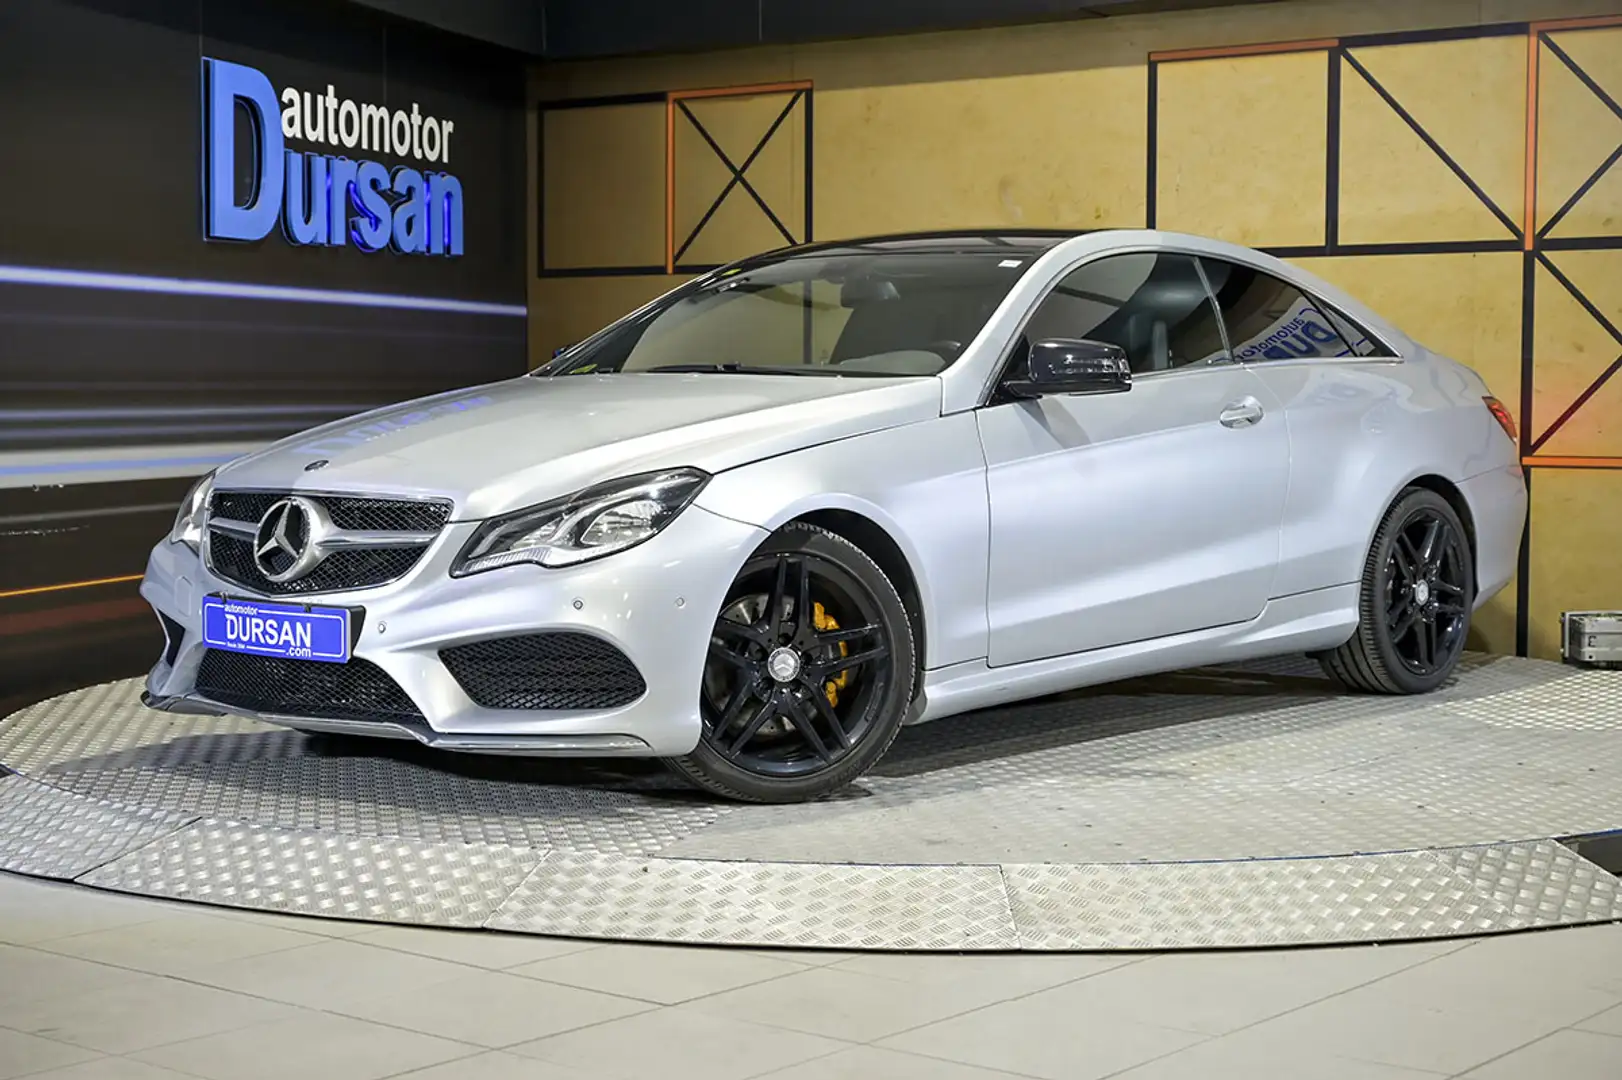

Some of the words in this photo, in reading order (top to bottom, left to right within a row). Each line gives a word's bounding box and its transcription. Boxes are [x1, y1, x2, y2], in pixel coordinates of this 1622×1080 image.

[281, 84, 454, 163] automotor
[201, 56, 464, 256] Dursan
[224, 603, 258, 616] automotor
[224, 613, 312, 648] DURSAN
[286, 646, 312, 658] .com
